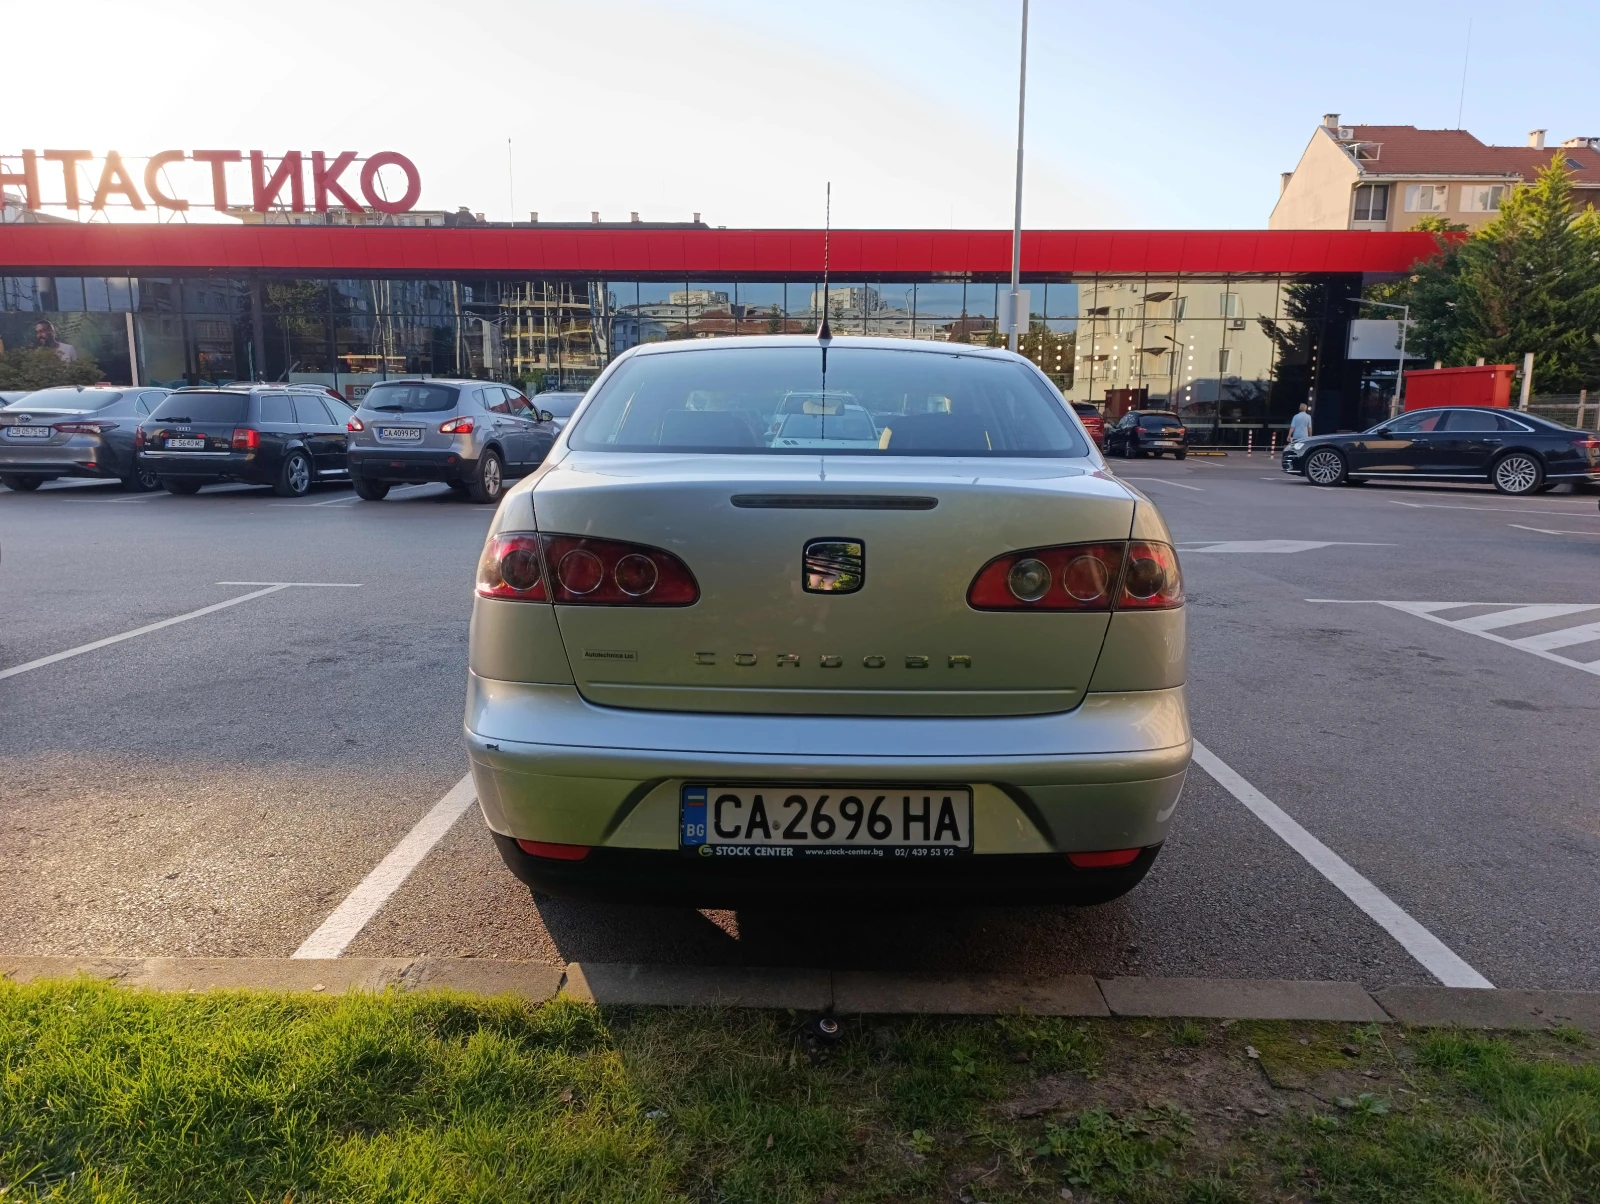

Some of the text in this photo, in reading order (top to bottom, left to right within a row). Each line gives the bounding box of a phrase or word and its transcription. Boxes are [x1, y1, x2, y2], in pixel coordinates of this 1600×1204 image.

[584, 651, 624, 659] Autotechnica
[694, 652, 972, 668] CORDOBA
[686, 824, 705, 838] BG
[715, 847, 750, 856] STOCK
[754, 847, 794, 857] CENTER
[804, 848, 884, 857] www.stock-center.bg
[911, 848, 928, 857] 439
[930, 848, 943, 857] 53
[943, 848, 955, 857] 92
